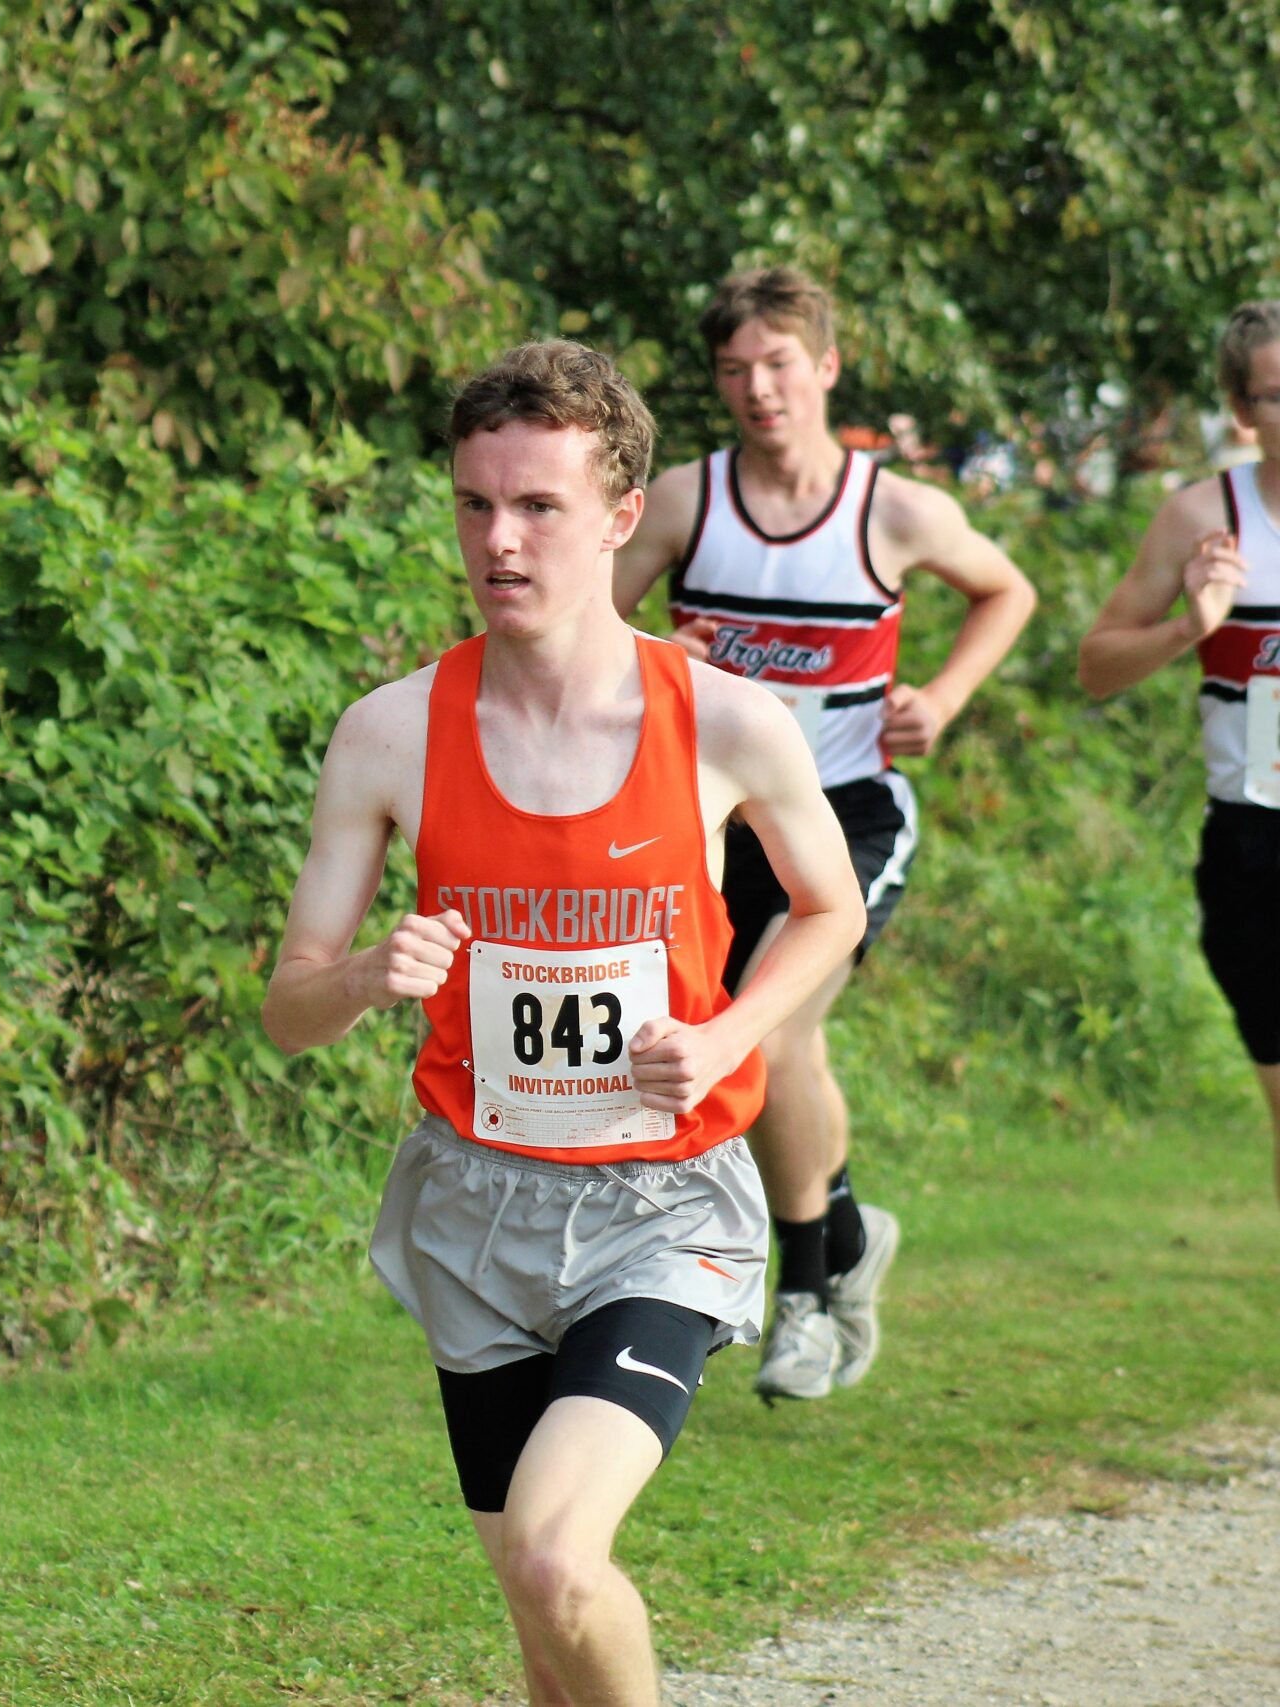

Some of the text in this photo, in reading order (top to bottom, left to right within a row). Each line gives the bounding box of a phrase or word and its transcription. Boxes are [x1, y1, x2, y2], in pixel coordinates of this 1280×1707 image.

[709, 624, 833, 678] Trojans
[501, 960, 631, 983] STOCKBRIDGE
[512, 992, 624, 1067] 843
[508, 1074, 632, 1096] INVITATIONAL
[621, 1131, 633, 1140] 843
